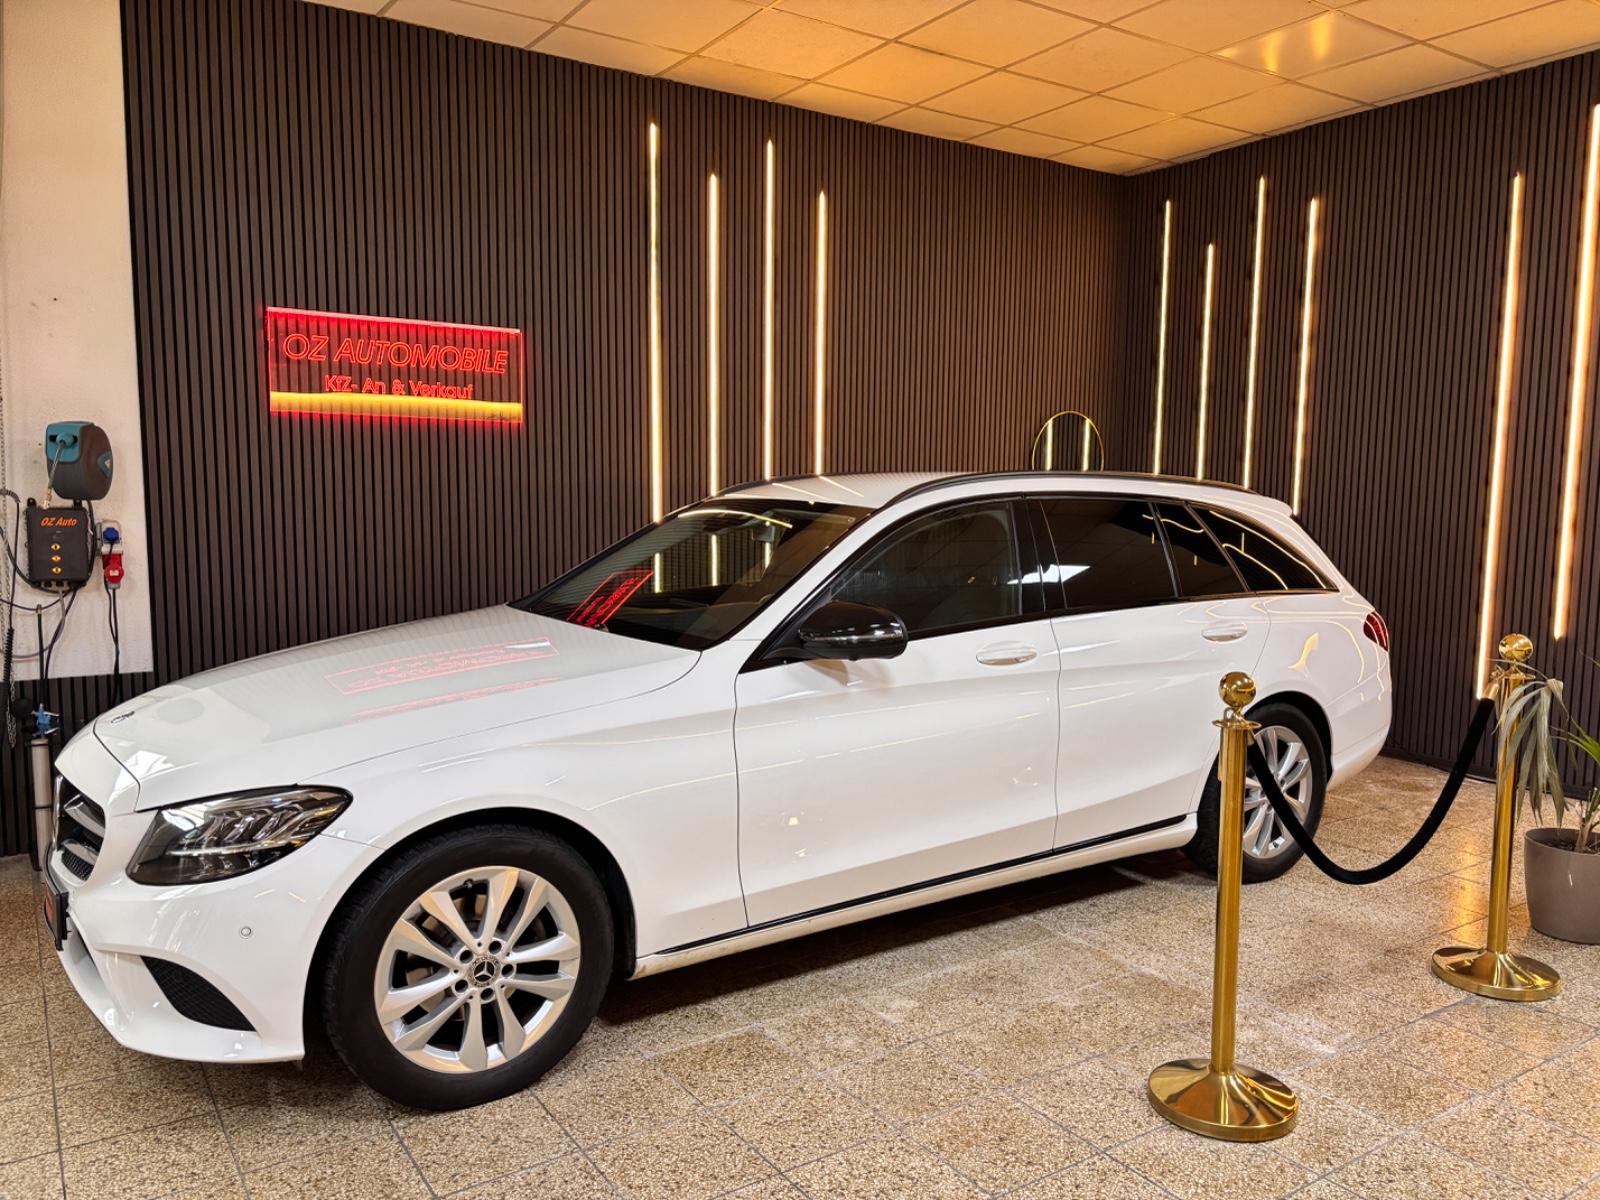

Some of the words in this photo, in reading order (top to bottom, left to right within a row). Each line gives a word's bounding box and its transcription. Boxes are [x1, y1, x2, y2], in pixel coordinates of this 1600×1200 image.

[284, 334, 328, 360] OZ
[334, 338, 508, 373] AUTOMOBILE
[362, 377, 386, 394] An
[392, 379, 405, 395] &
[409, 380, 473, 399] Verkauf
[41, 517, 56, 526] OZ
[56, 517, 77, 526] Auto
